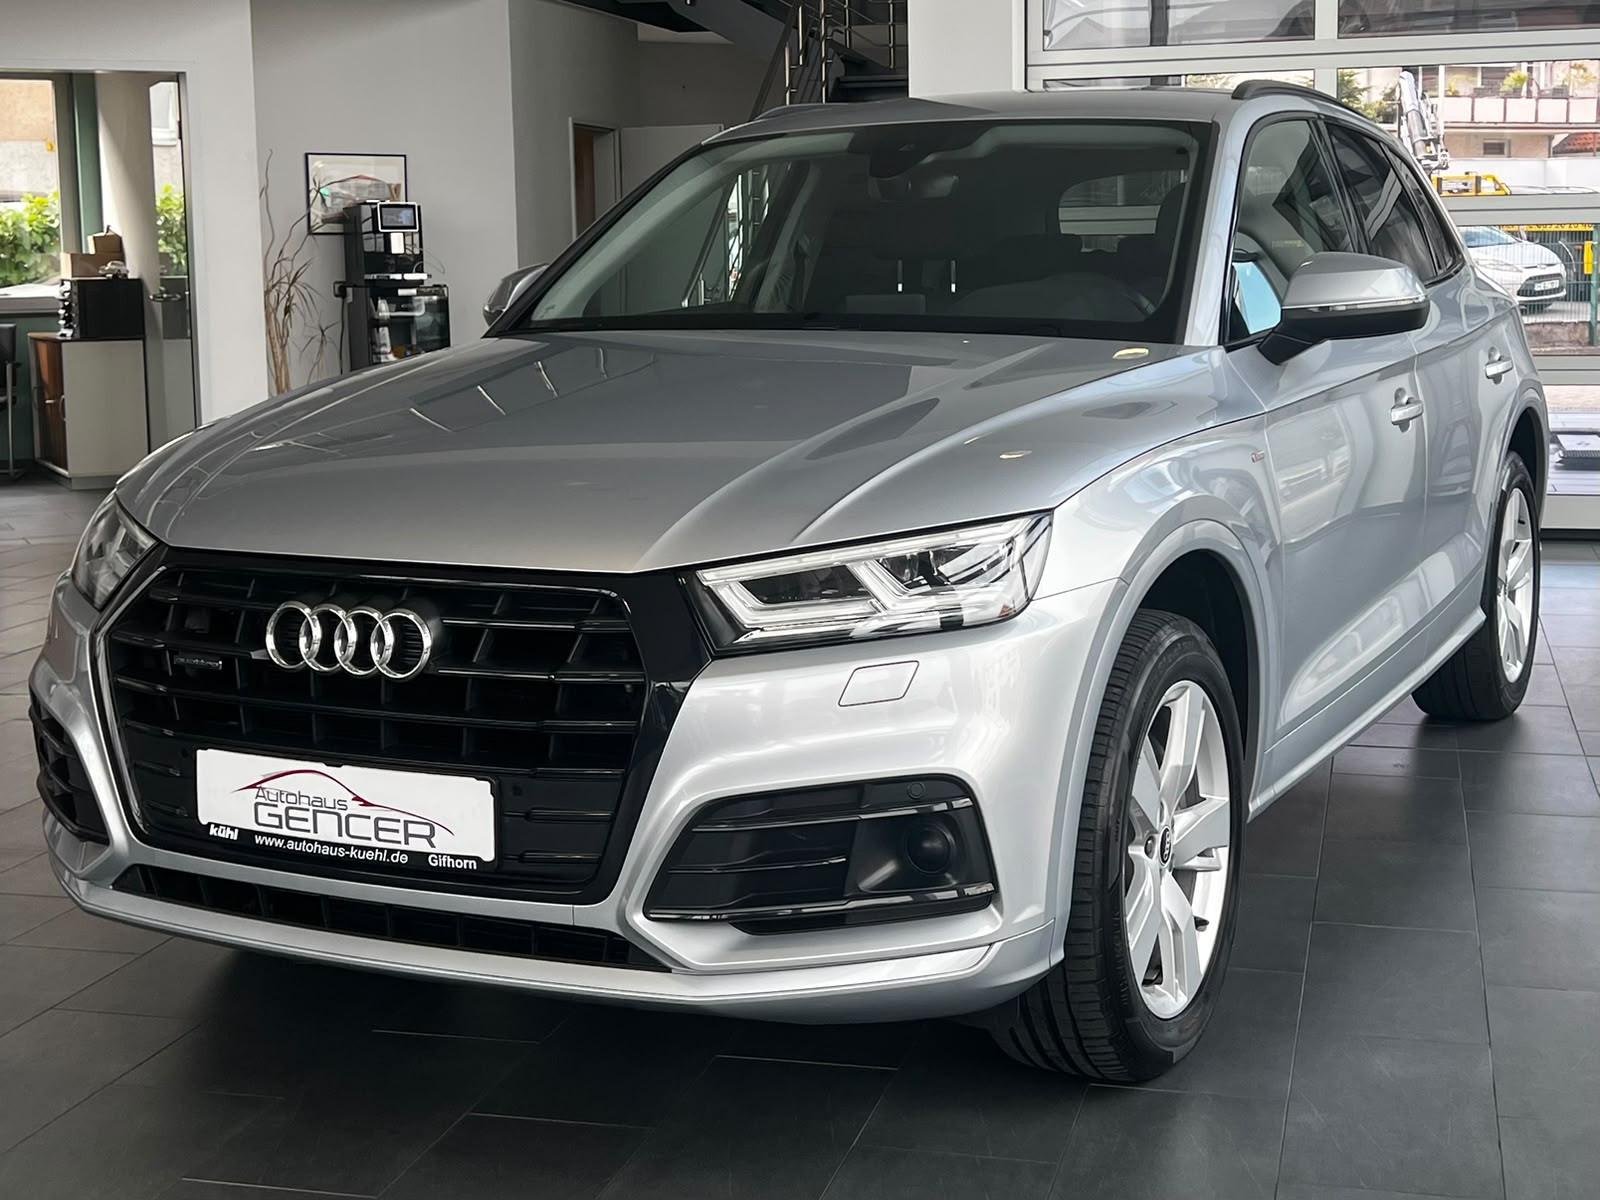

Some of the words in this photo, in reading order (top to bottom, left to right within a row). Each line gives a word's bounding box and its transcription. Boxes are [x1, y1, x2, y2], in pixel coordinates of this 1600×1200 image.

[255, 786, 348, 811] Autohaus
[253, 802, 437, 849] GENCER
[254, 834, 409, 864] www.autohaus-kuehl.de
[427, 854, 478, 870] Gifhorn
